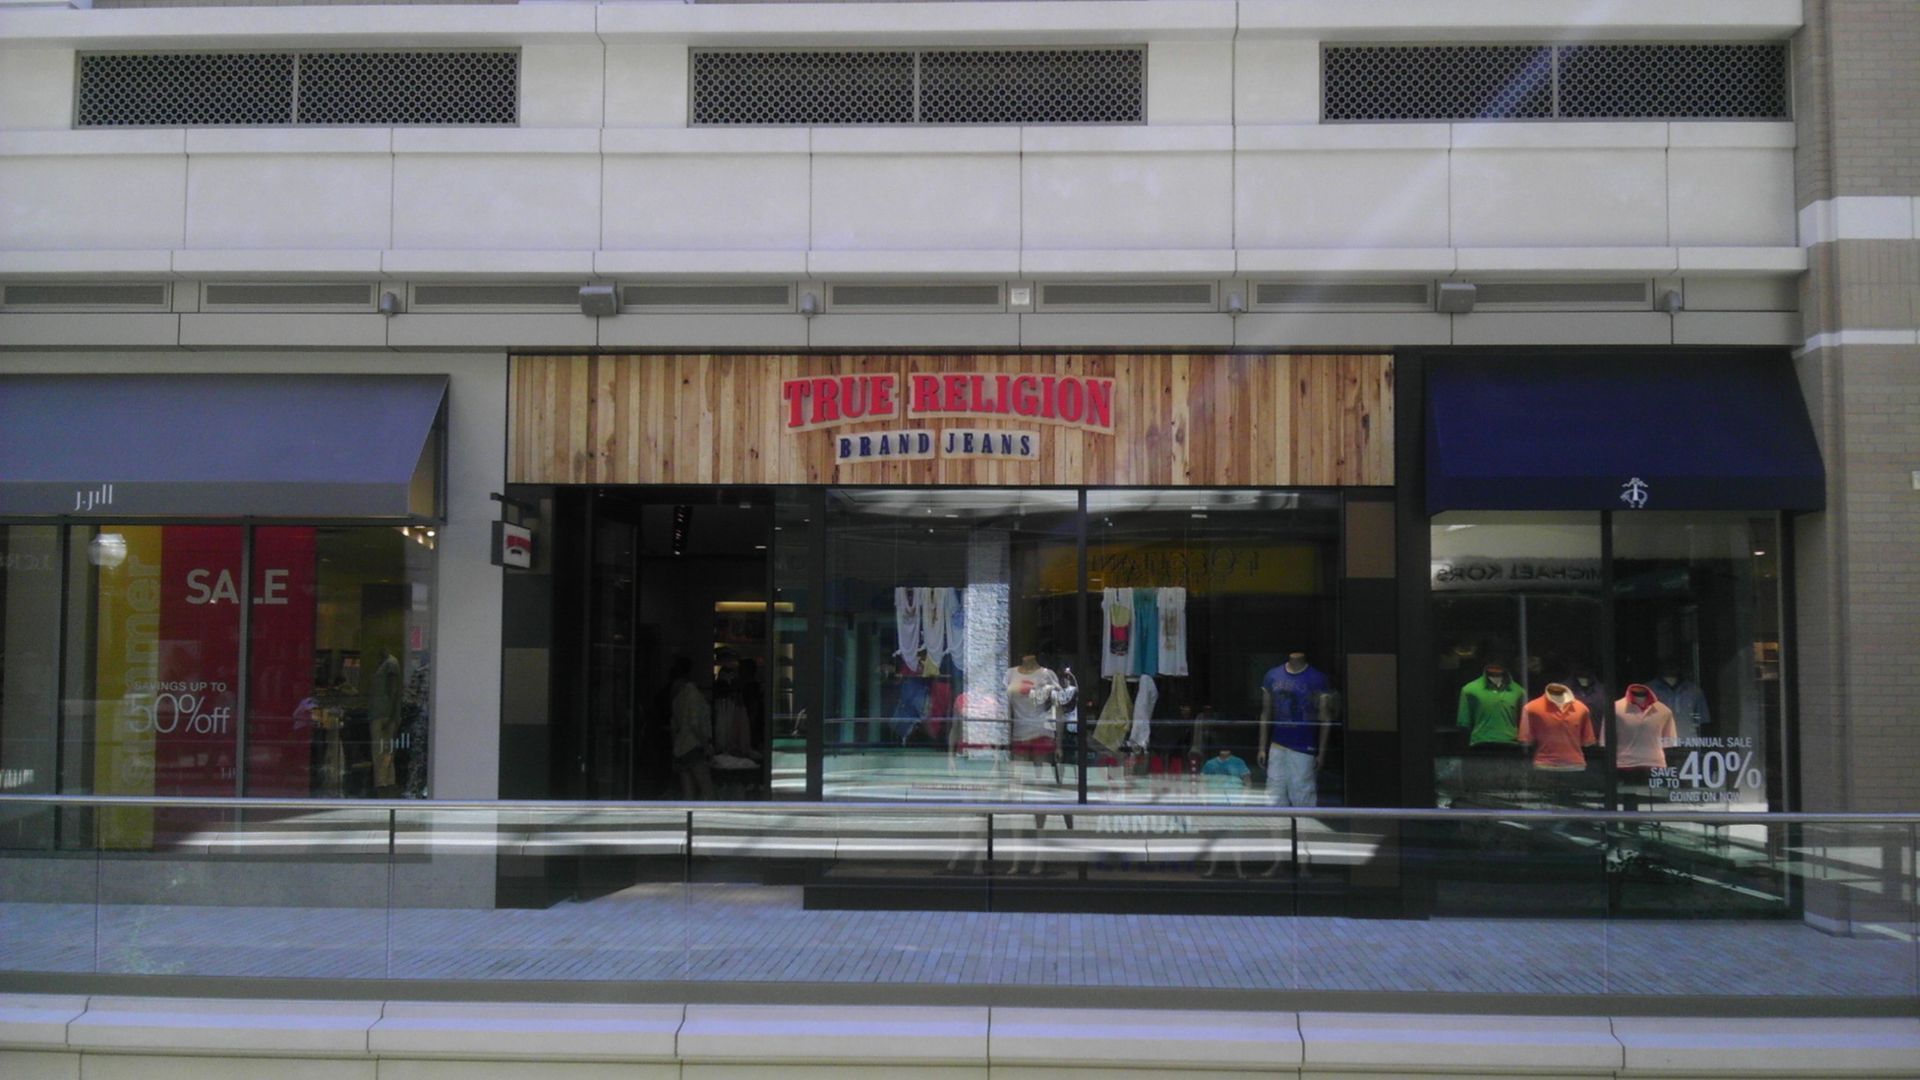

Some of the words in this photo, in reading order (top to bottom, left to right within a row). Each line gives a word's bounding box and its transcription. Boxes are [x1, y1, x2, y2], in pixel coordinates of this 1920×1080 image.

[783, 374, 896, 429] TRUE
[911, 373, 1113, 430] RELIGION
[838, 433, 932, 460] BRAND
[945, 430, 1032, 458] JEANS
[185, 569, 289, 605] SAE
[189, 681, 208, 691] UP
[210, 681, 227, 692] TO
[1726, 737, 1753, 748] SALE
[1650, 767, 1678, 778] SAVE
[1679, 751, 1762, 789] 40%
[1648, 778, 1663, 789] UP
[1665, 778, 1680, 789] TO
[1669, 791, 1701, 802] GOING
[1702, 791, 1717, 802] ON
